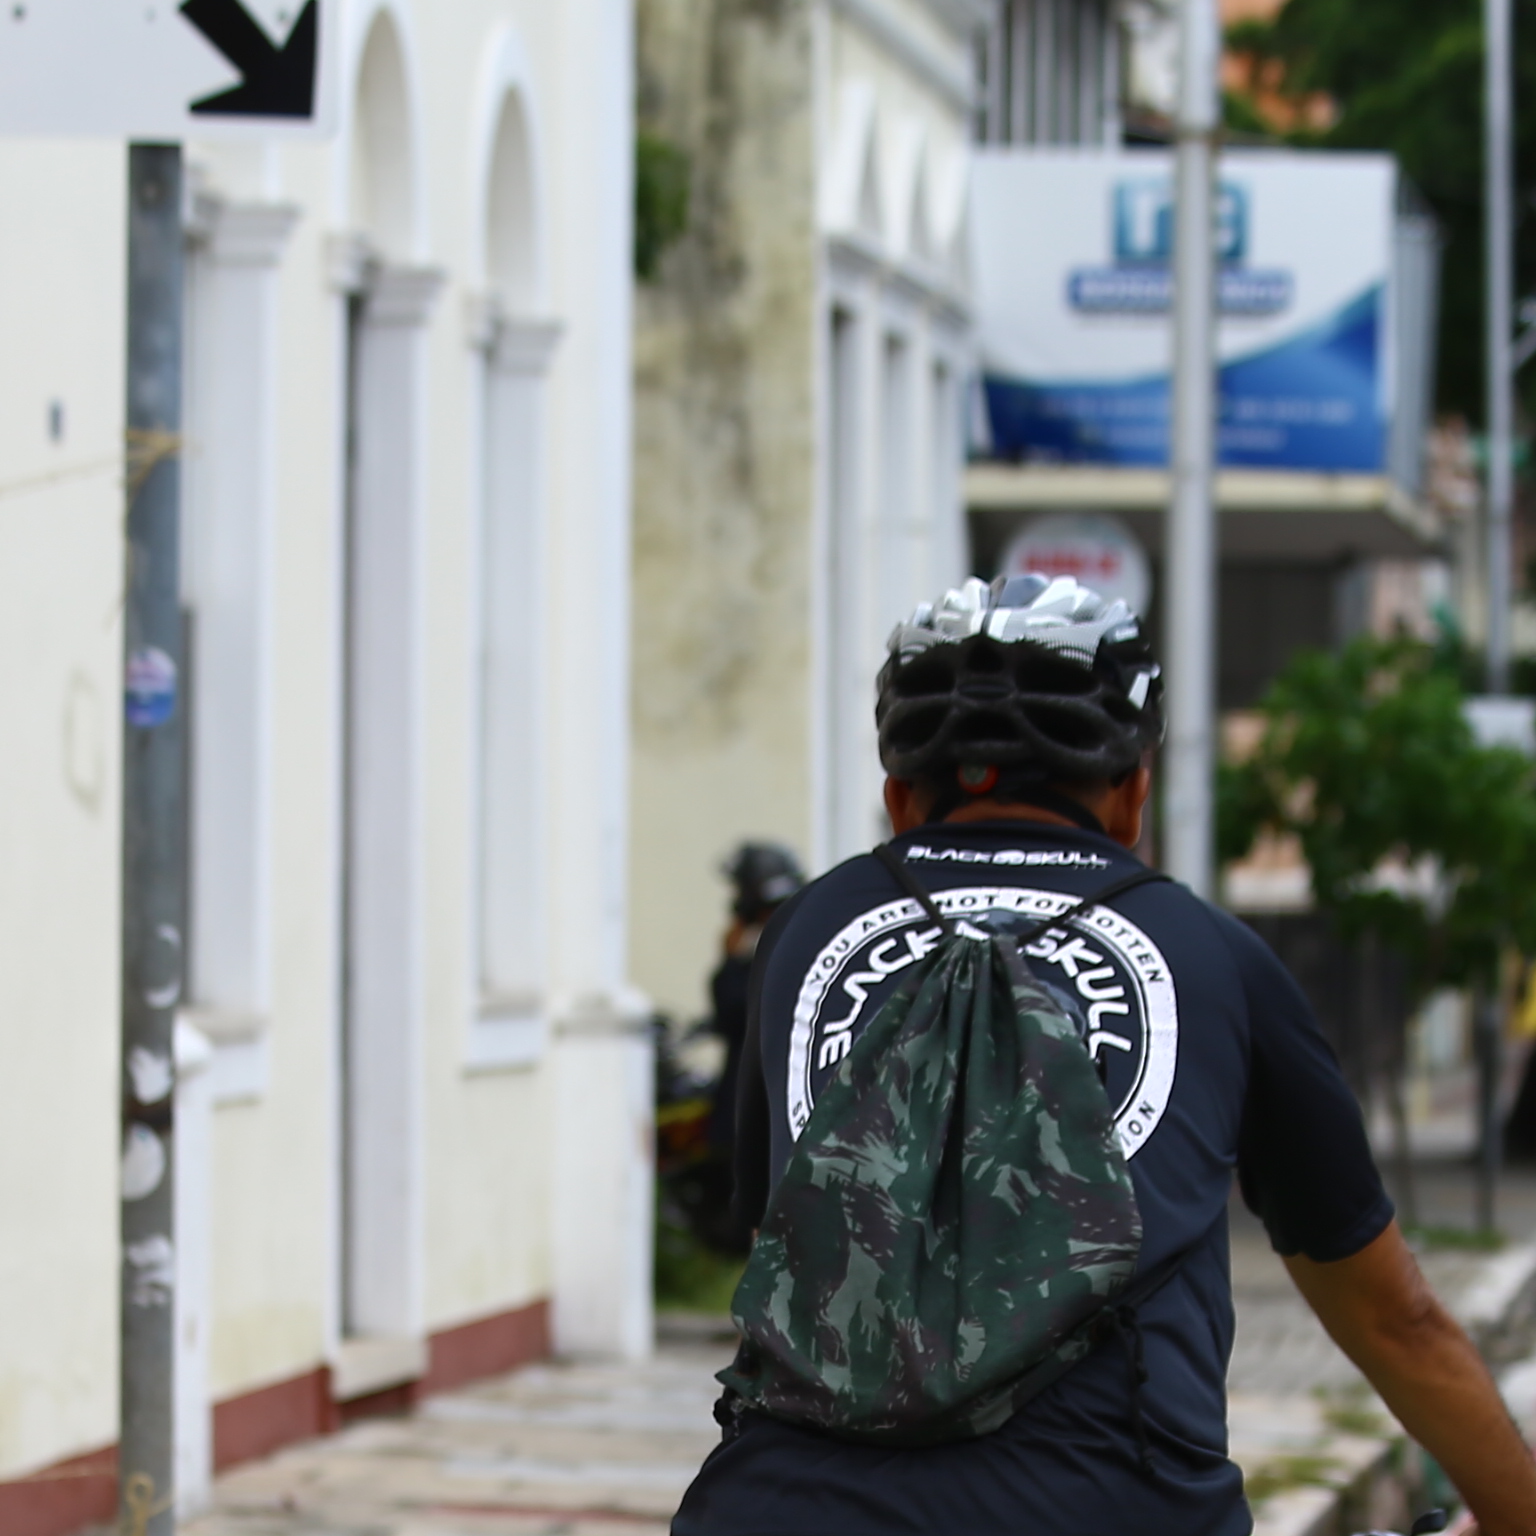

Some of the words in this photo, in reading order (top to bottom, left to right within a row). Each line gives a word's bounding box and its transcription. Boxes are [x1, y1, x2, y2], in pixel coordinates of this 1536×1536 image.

[907, 845, 993, 863] BLACK
[1024, 850, 1110, 867] SKULL
[810, 938, 850, 984] YOU
[862, 903, 920, 931] ARE
[934, 894, 1000, 910] NOT
[1024, 927, 1133, 1061] SKULL
